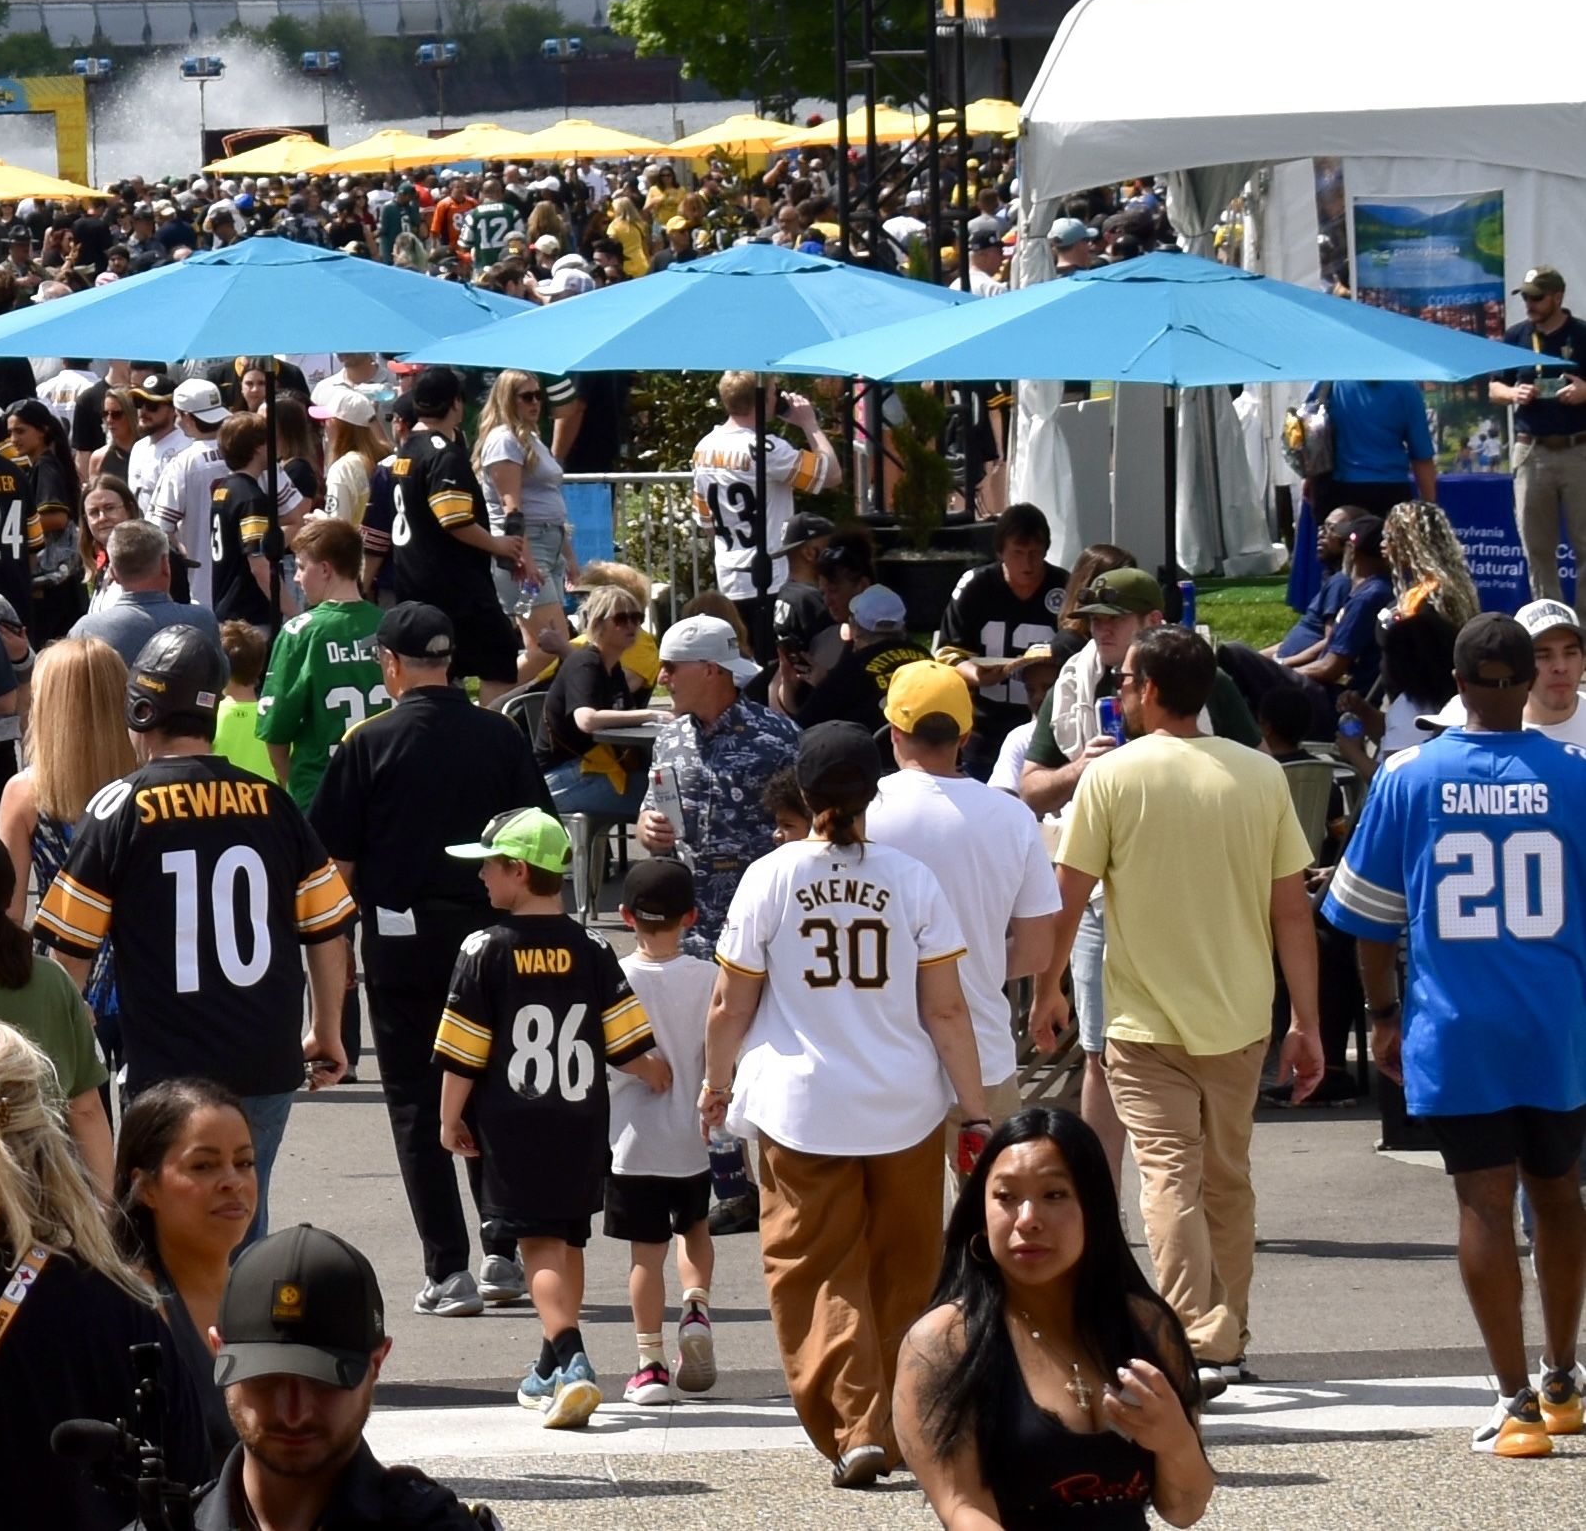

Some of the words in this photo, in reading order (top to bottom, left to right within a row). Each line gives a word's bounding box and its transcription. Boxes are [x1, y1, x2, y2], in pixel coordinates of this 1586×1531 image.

[478, 217, 508, 249] 12
[1464, 559, 1524, 577] Natural
[85, 778, 132, 821] 10
[136, 780, 270, 824] STEWART
[1442, 783, 1549, 814] SANDERS
[795, 879, 890, 913] SKENES
[1434, 830, 1565, 940] 20
[162, 844, 272, 993] 10
[513, 948, 572, 975] WARD
[797, 918, 891, 990] 30
[507, 1002, 595, 1102] 86
